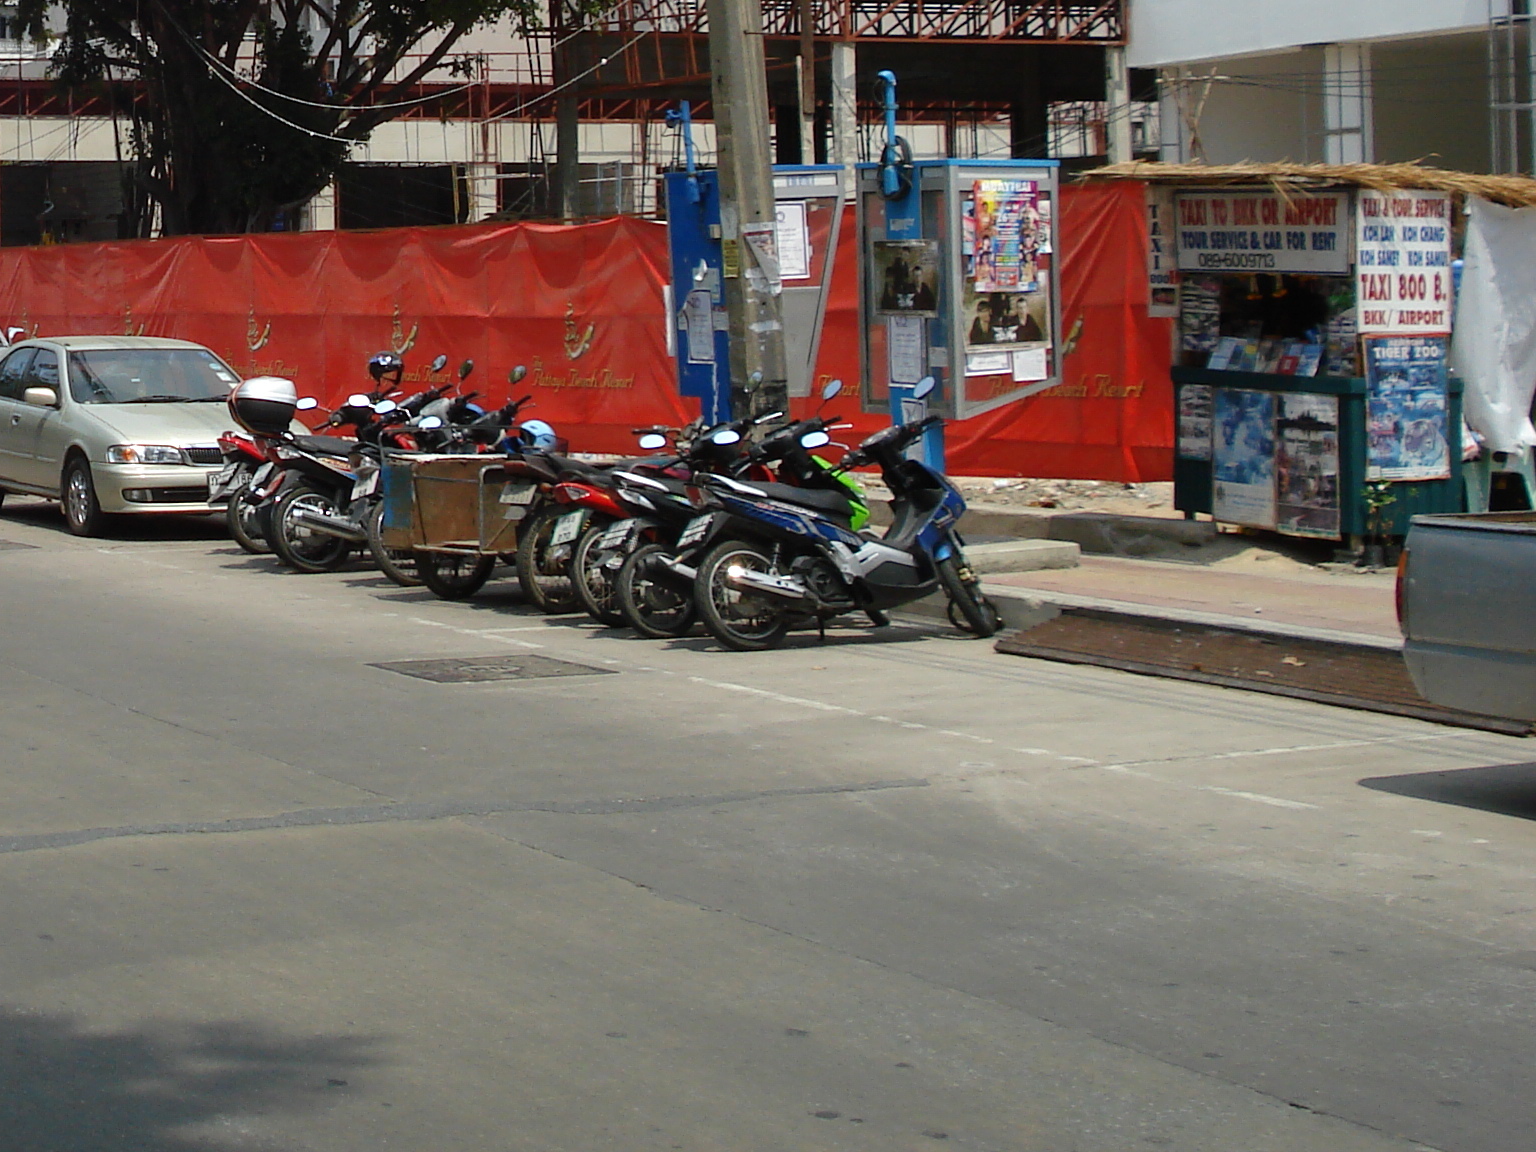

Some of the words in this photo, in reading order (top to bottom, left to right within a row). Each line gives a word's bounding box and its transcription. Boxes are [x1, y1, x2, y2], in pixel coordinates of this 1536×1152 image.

[1179, 199, 1207, 226] TAXI
[1211, 199, 1228, 226] TO
[1262, 198, 1279, 226] OR
[1285, 198, 1338, 226] AIRPORT
[1148, 204, 1163, 270] TAXI
[1182, 231, 1208, 249] TOUR
[1210, 231, 1248, 249] SERVICE
[1250, 231, 1261, 249] &
[1264, 231, 1282, 250] CAR
[1286, 231, 1307, 251] FOR
[1312, 231, 1337, 251] RENT
[1363, 225, 1379, 242] KOH
[1402, 226, 1419, 242] KOH
[1360, 250, 1375, 266] KOH
[1408, 251, 1423, 266] KOH
[1361, 274, 1392, 300] TAXI
[1398, 273, 1427, 300] 800
[1398, 310, 1444, 325] AIRPORT
[1373, 346, 1410, 359] TIGER
[1415, 346, 1440, 358] ZOO
